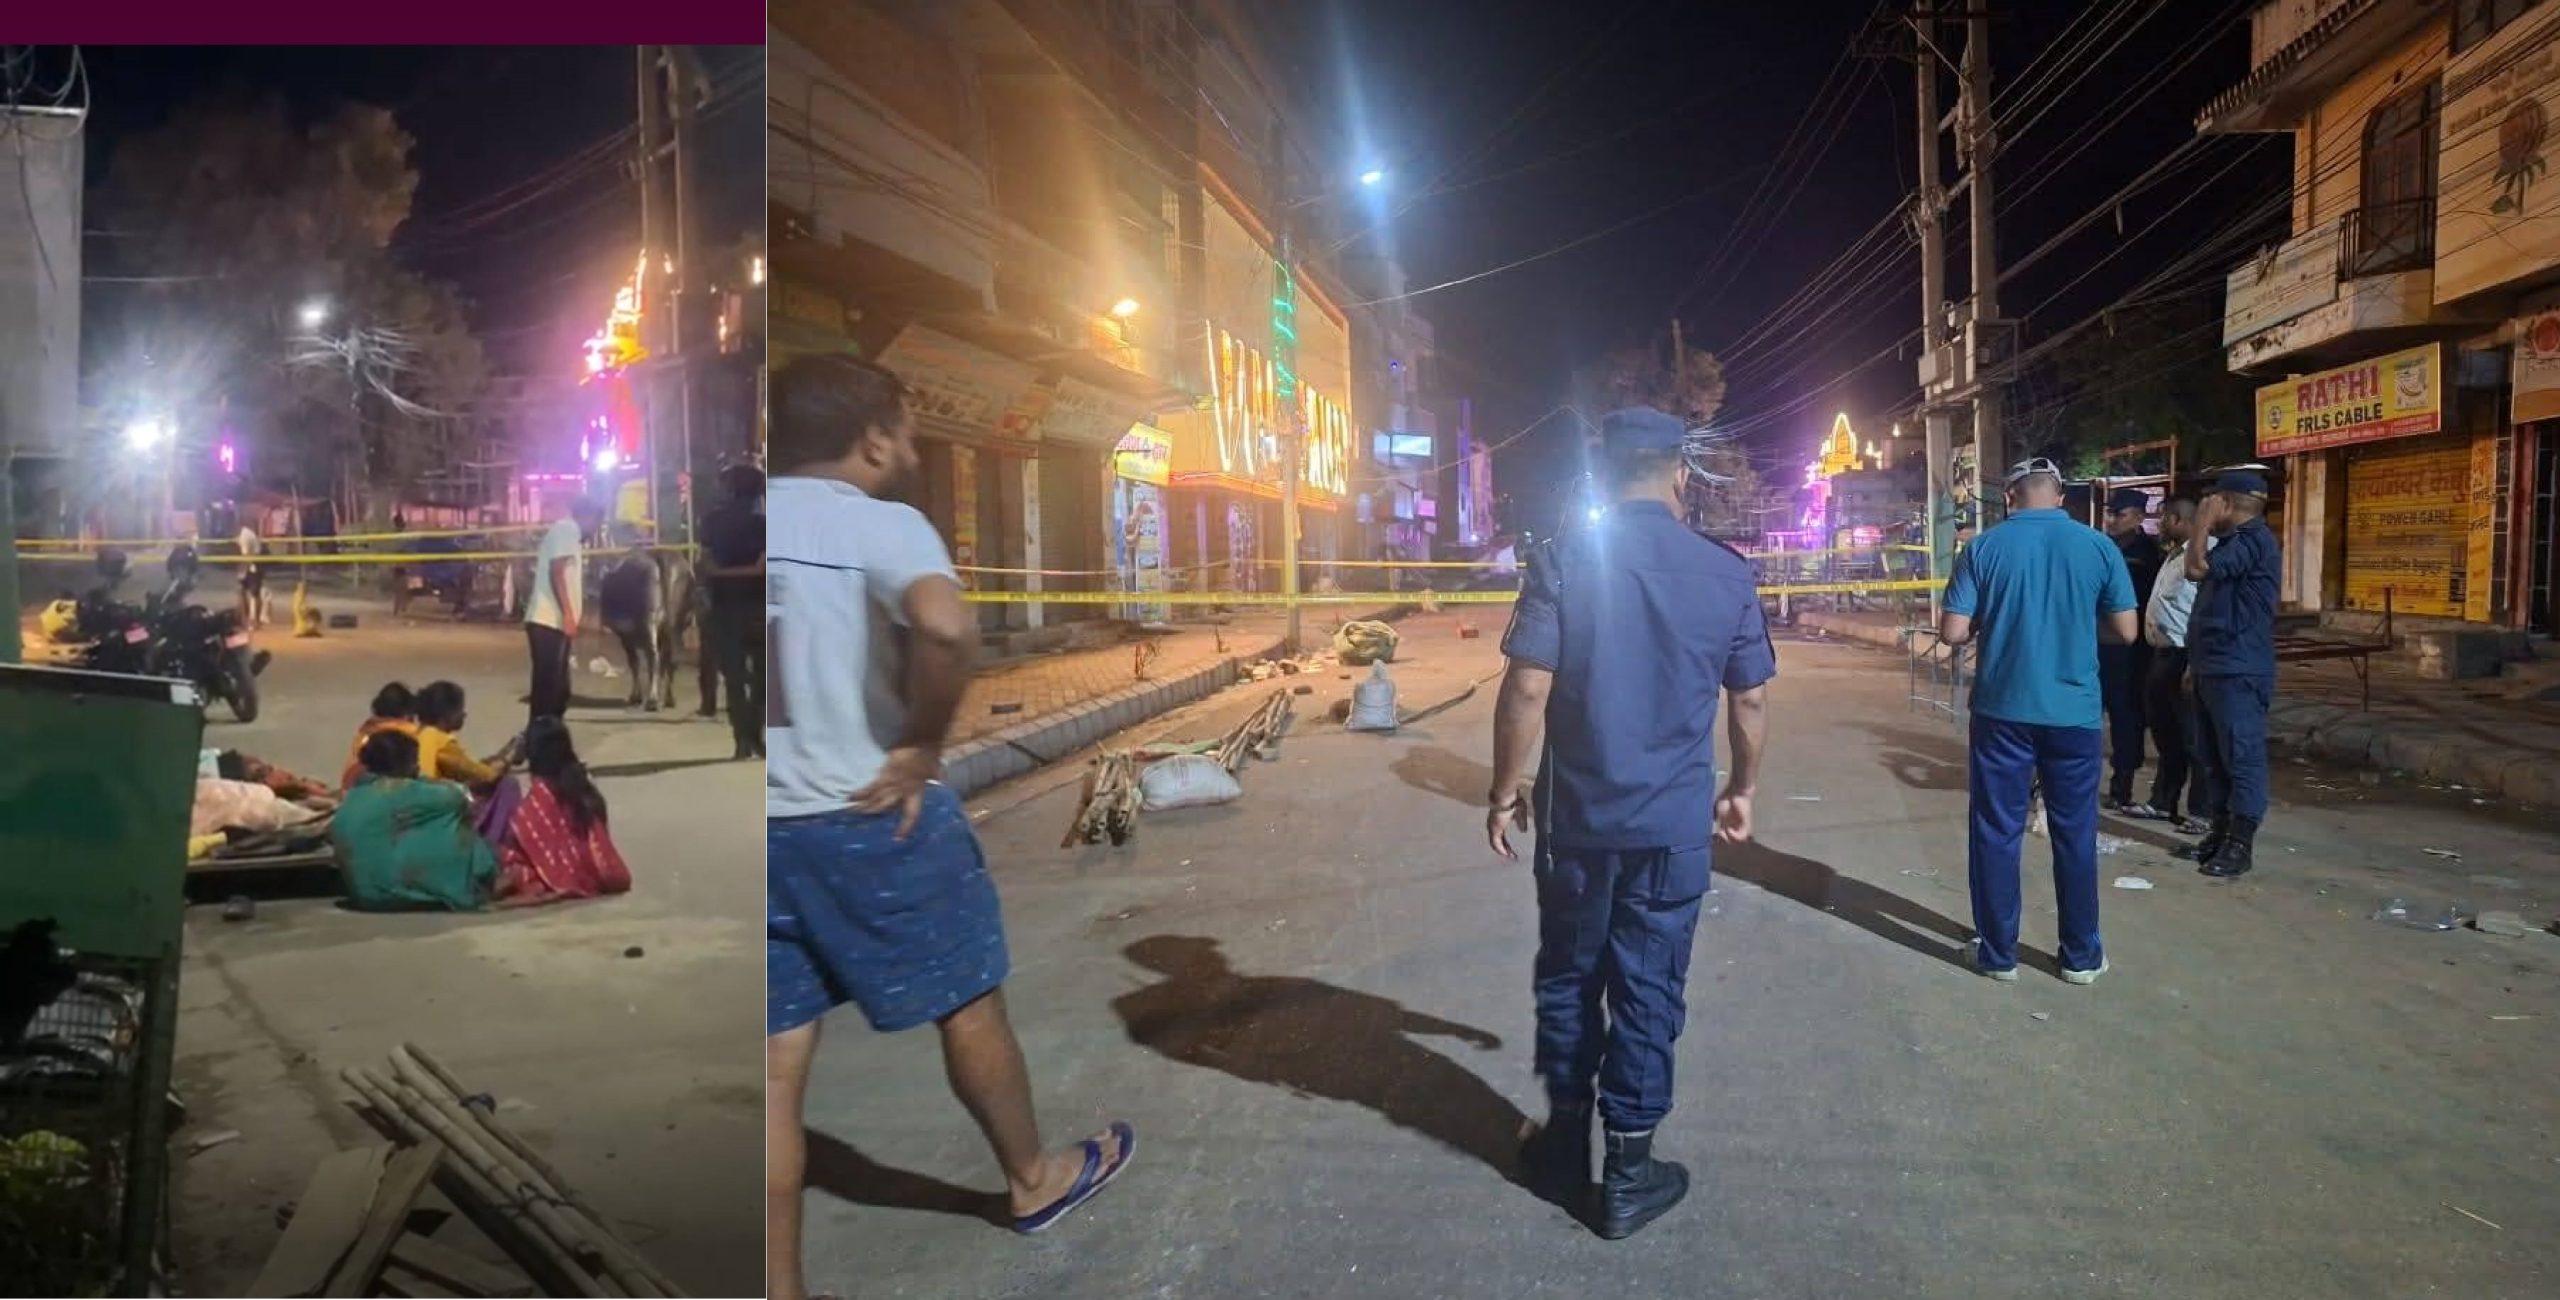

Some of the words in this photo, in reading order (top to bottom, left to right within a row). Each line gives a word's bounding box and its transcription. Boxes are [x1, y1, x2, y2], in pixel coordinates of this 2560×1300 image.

[2297, 365, 2380, 412] RATHI
[2296, 413, 2331, 434] FRLS
[2334, 402, 2384, 427] CABLE
